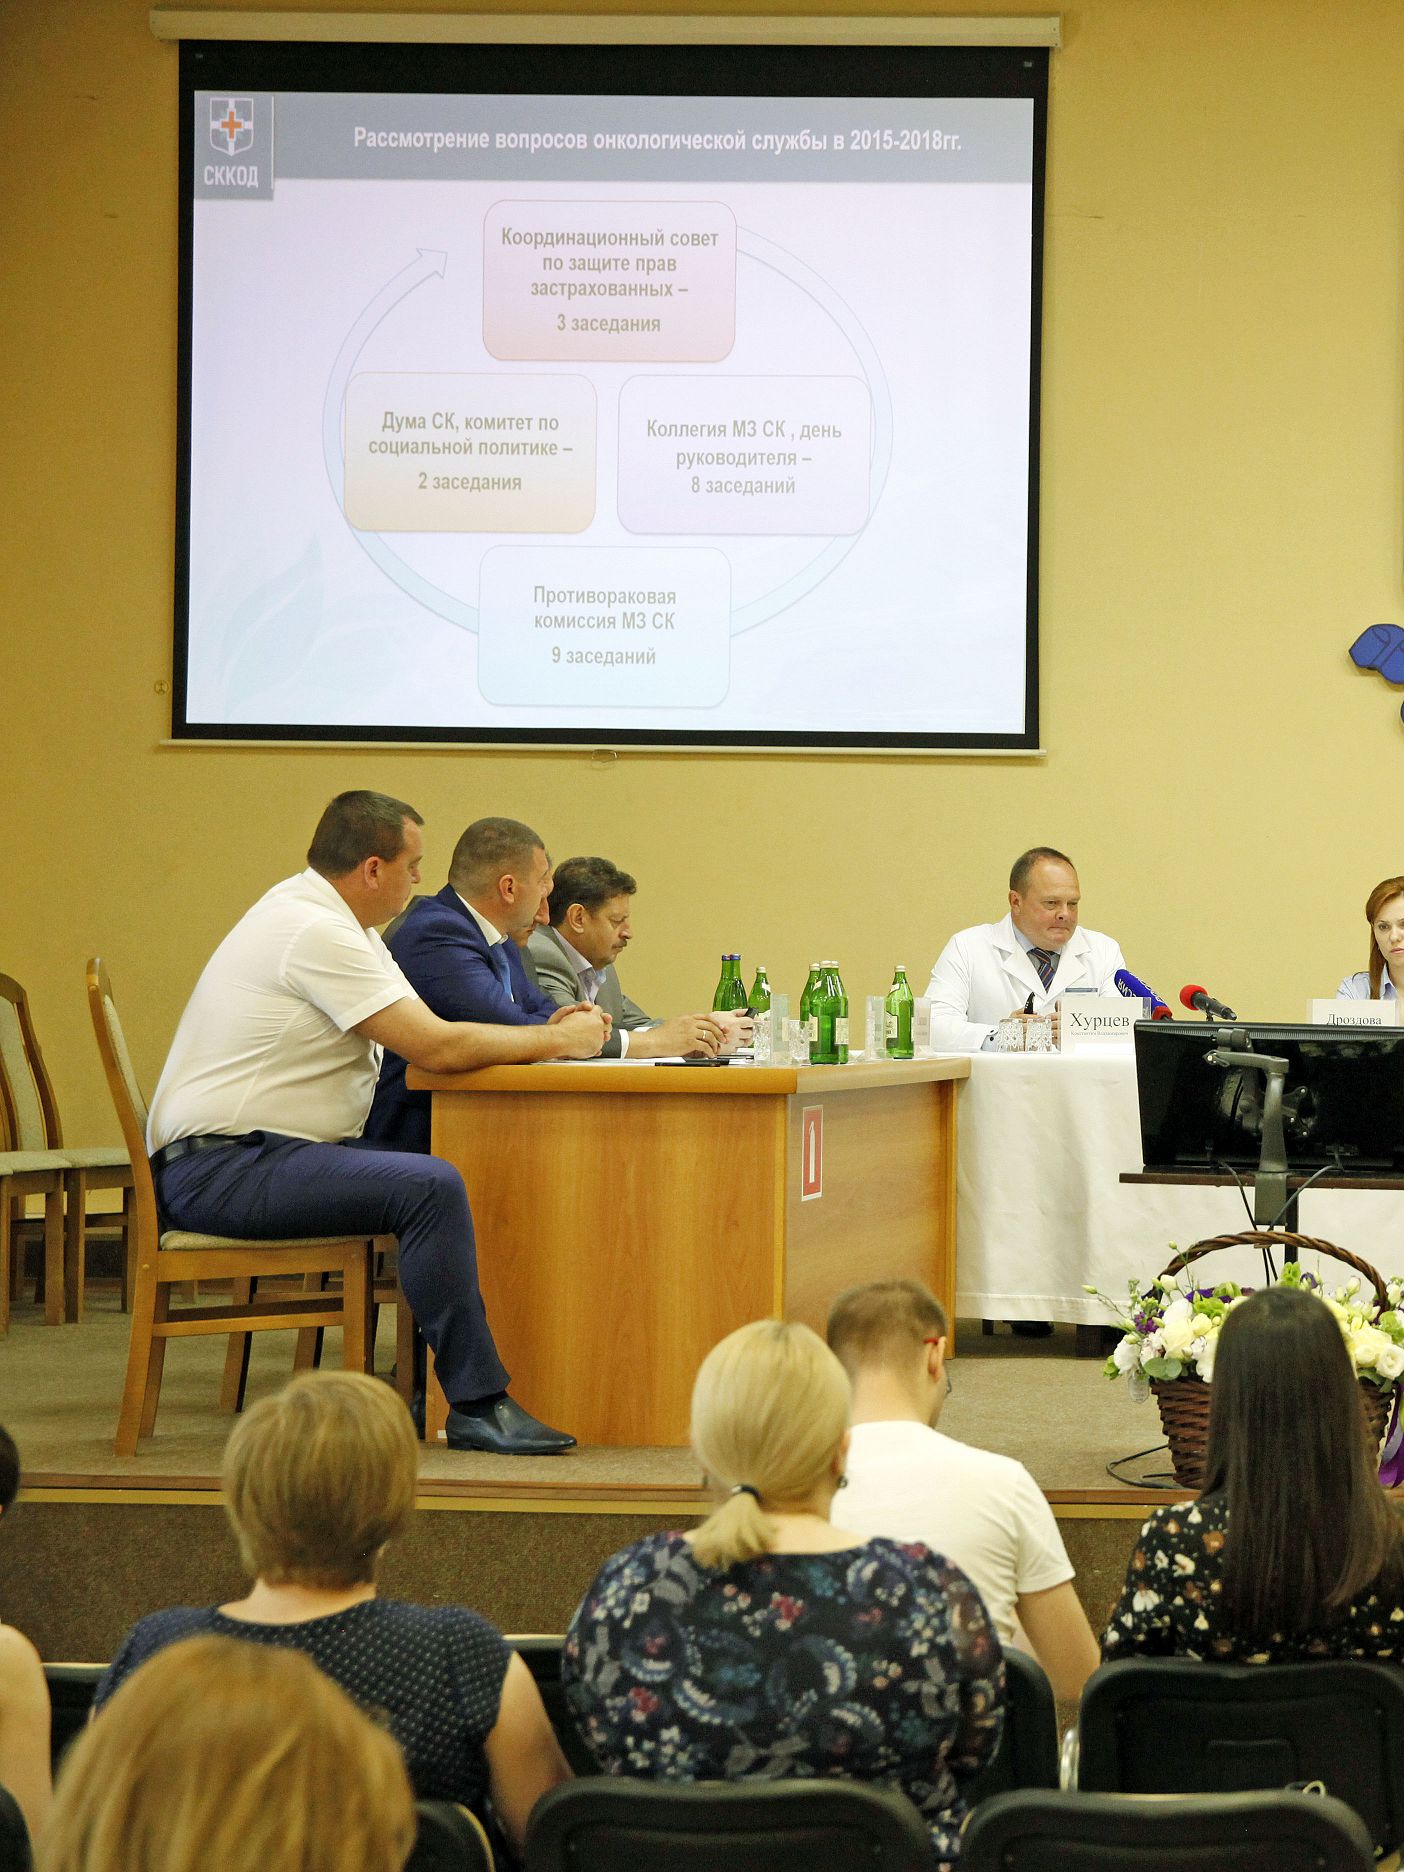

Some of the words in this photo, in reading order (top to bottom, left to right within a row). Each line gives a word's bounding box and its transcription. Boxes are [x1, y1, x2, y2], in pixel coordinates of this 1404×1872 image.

[354, 126, 490, 153] Рассмотрение
[495, 131, 587, 153] вопросов
[593, 130, 746, 151] онкологической
[752, 129, 827, 155] службы
[833, 134, 845, 150] в
[850, 129, 962, 151] 2015-2018гг.
[203, 165, 259, 188] СККОД
[501, 227, 664, 249] Координационный
[670, 232, 719, 247] совет
[543, 257, 563, 272] по
[568, 257, 630, 273] защите
[636, 257, 677, 275] прав
[530, 282, 673, 300] застрахованных
[557, 313, 566, 331] 3
[571, 317, 661, 334] заседания
[382, 411, 426, 433] Дума
[432, 412, 459, 433] СК,
[465, 416, 533, 431] комитет
[538, 417, 559, 431] по
[647, 419, 727, 438] Коллегия
[762, 420, 786, 437] СК
[800, 425, 842, 441] день
[368, 438, 473, 456] социальной
[478, 442, 558, 456] политике
[676, 451, 797, 470] руководителя
[418, 472, 427, 489] 2
[433, 476, 522, 492] заседания
[691, 475, 700, 493] 8
[705, 477, 796, 496] заседаний
[534, 586, 676, 608] Противораковая
[534, 614, 616, 629] комиссия
[652, 611, 676, 630] СК
[552, 646, 561, 663] 9
[566, 647, 656, 667] заседаний
[1069, 1012, 1130, 1031] Хурцев
[1326, 1013, 1382, 1026] Дроздова
